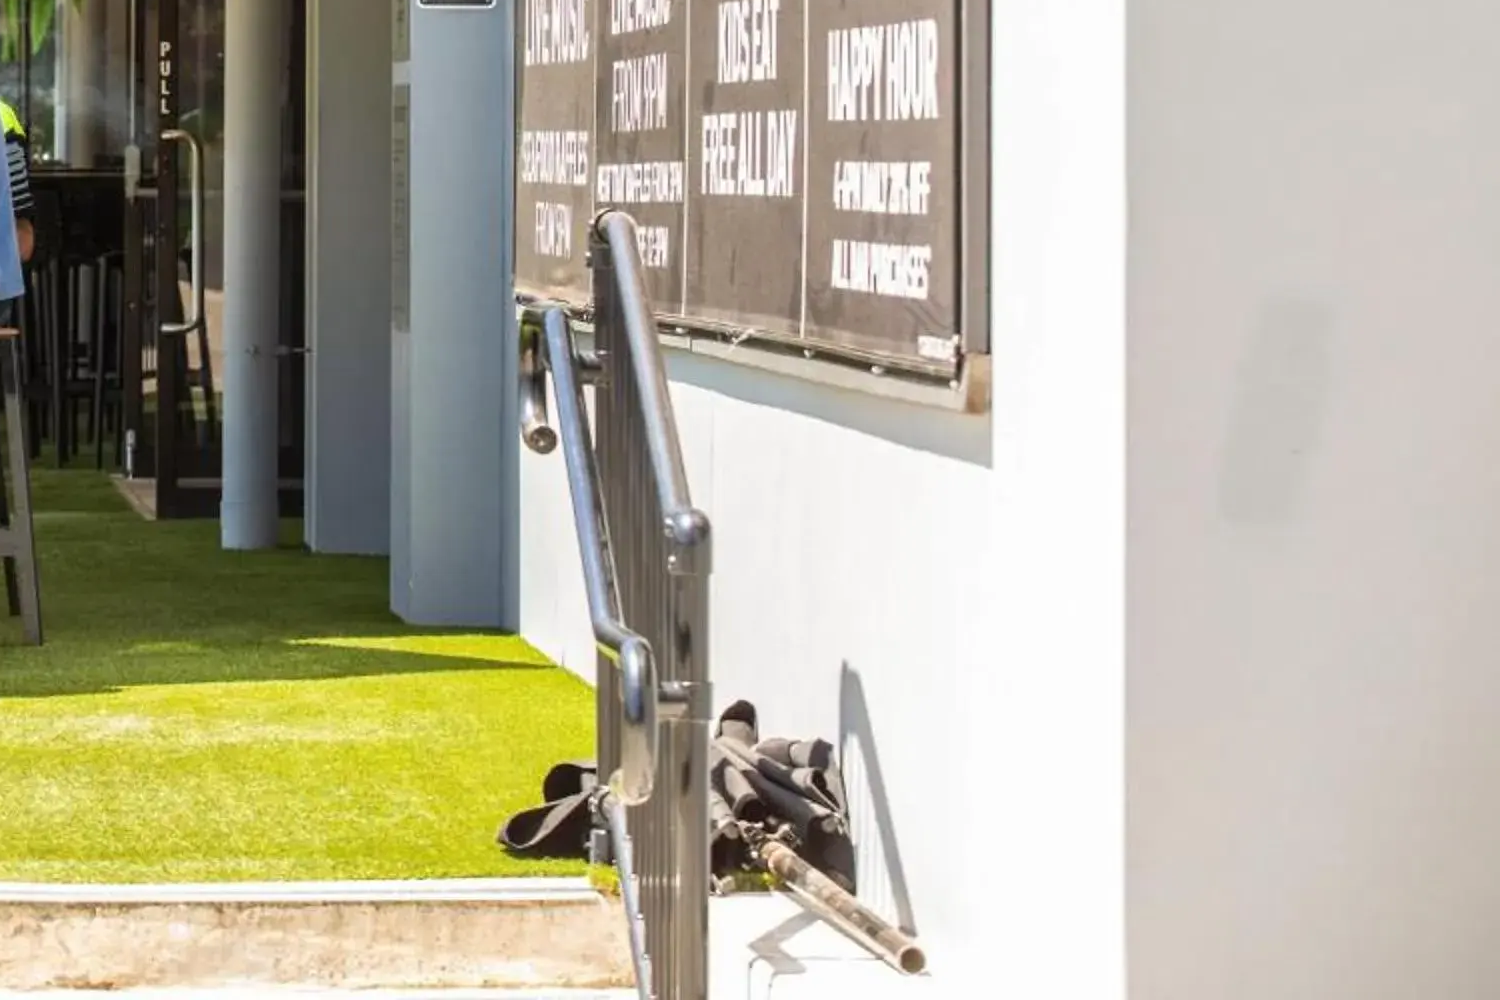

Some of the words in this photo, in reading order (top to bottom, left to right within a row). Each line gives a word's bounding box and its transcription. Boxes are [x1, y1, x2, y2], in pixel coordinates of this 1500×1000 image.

[160, 41, 171, 115] PULL
[611, 56, 640, 132] FROM
[828, 24, 883, 122] HAPPY
[886, 17, 938, 120] HOUR
[702, 112, 736, 195] FREE
[737, 111, 763, 196] ALL
[767, 109, 796, 197] DAY
